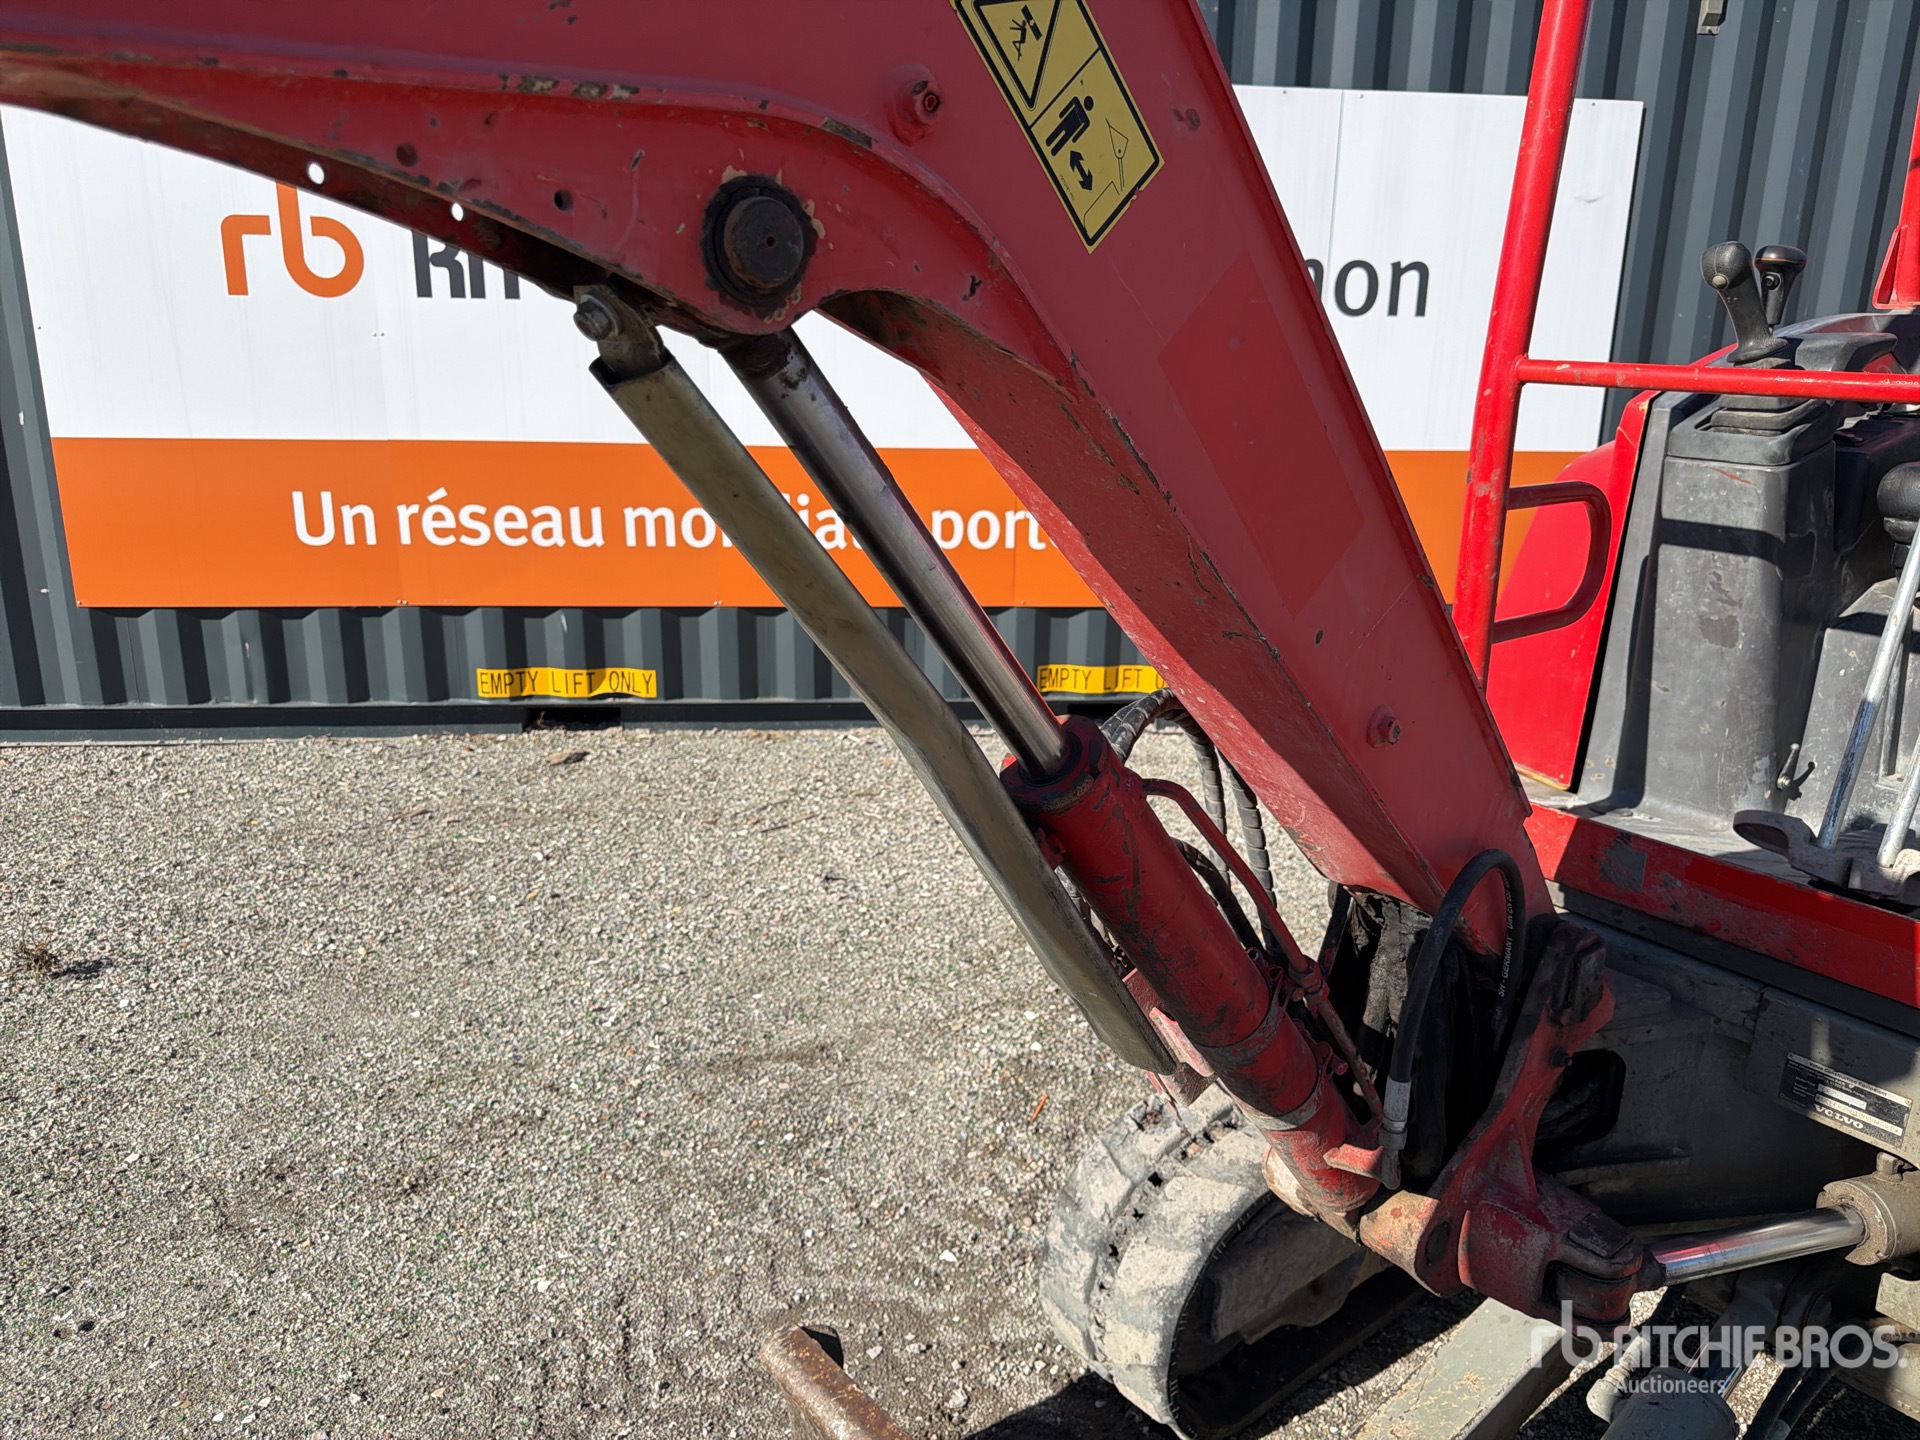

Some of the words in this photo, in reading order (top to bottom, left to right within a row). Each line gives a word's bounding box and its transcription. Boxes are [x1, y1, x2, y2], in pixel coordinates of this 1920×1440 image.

[221, 180, 364, 298] rb
[291, 490, 377, 546] Un
[396, 487, 605, 548] réseau
[623, 493, 864, 550] moia
[927, 507, 1059, 550] port
[480, 670, 538, 695] EMPTY
[552, 671, 597, 695] LIFT
[608, 670, 653, 695] ONLY
[1039, 667, 1092, 691] EMPTY
[1103, 667, 1143, 691] LIFT
[1501, 936, 1514, 979] GERMANY
[1814, 1104, 1864, 1129] VOLVO
